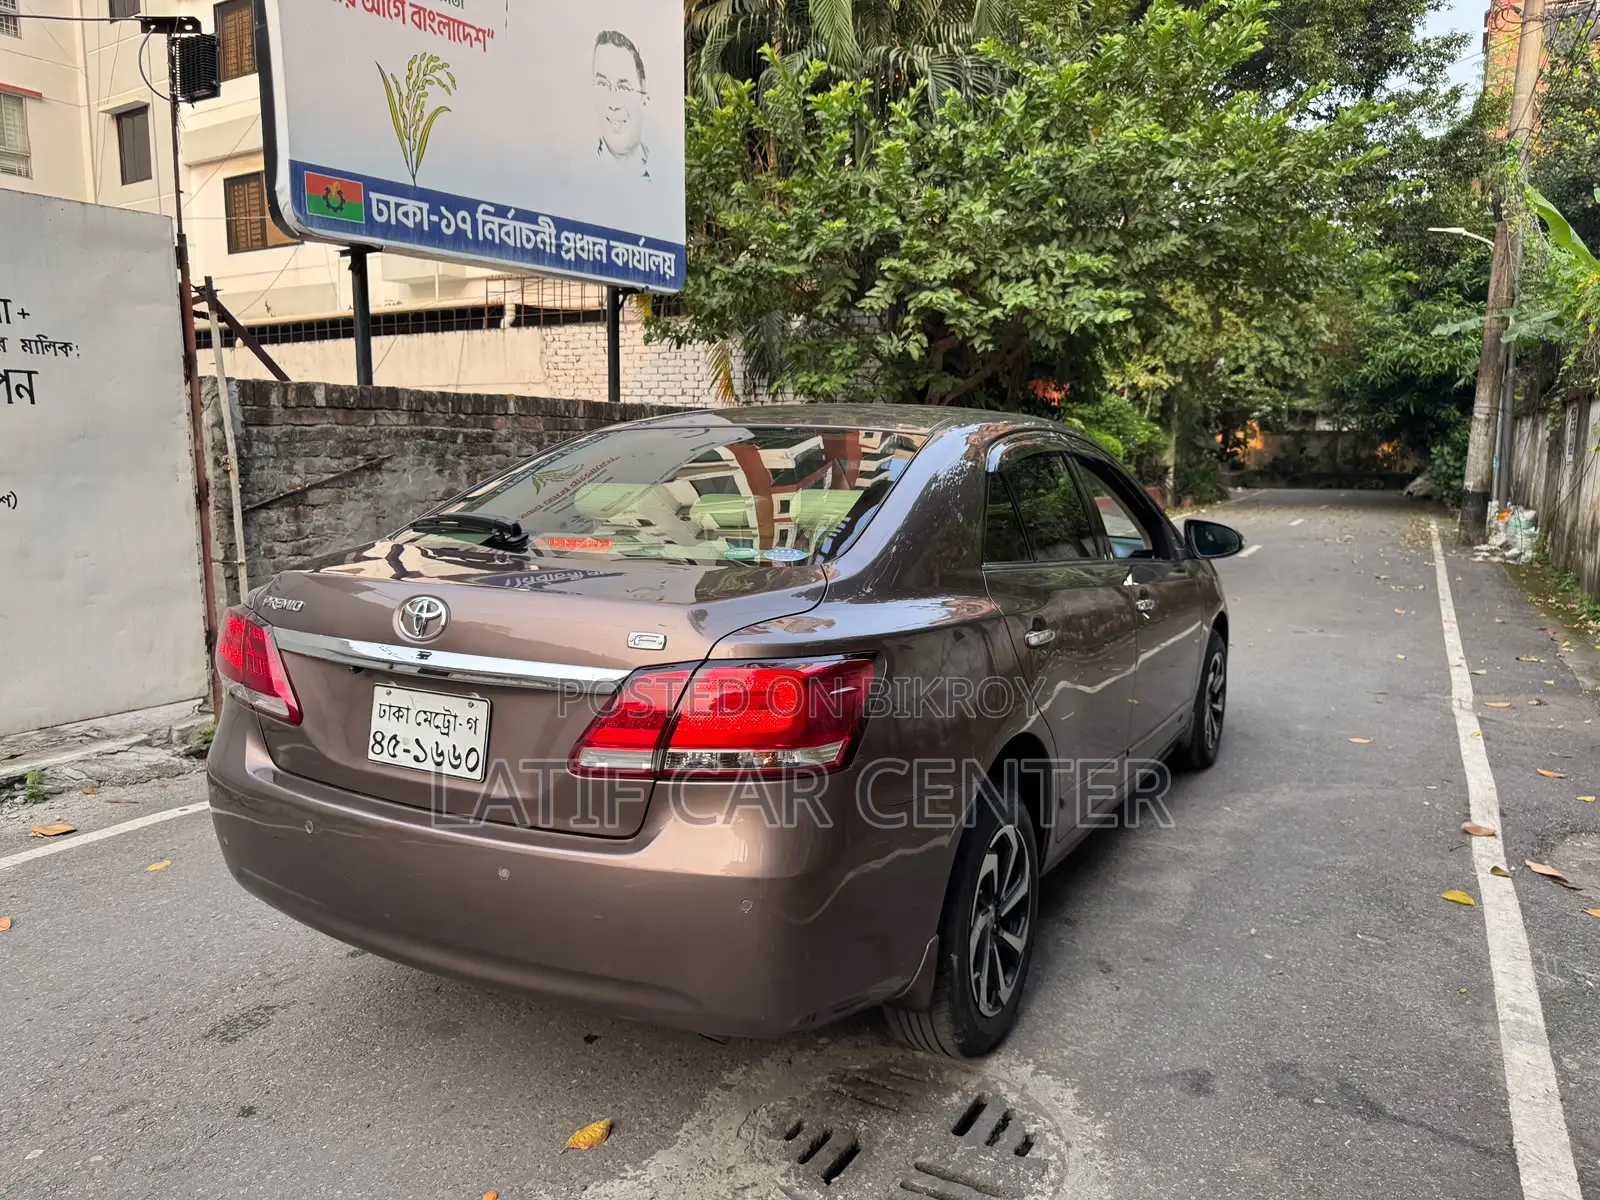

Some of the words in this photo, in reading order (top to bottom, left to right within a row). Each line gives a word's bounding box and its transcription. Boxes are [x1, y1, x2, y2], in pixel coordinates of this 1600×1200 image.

[368, 191, 473, 240] ঢাকা-১৭
[476, 203, 556, 254] নির্বাচনী
[560, 231, 607, 263] প্রধান
[609, 236, 676, 280] কার্যালয়
[262, 595, 306, 612] PREMIO
[379, 703, 411, 724] ঢাকা
[371, 730, 480, 773] ৪৫-১৬৬০
